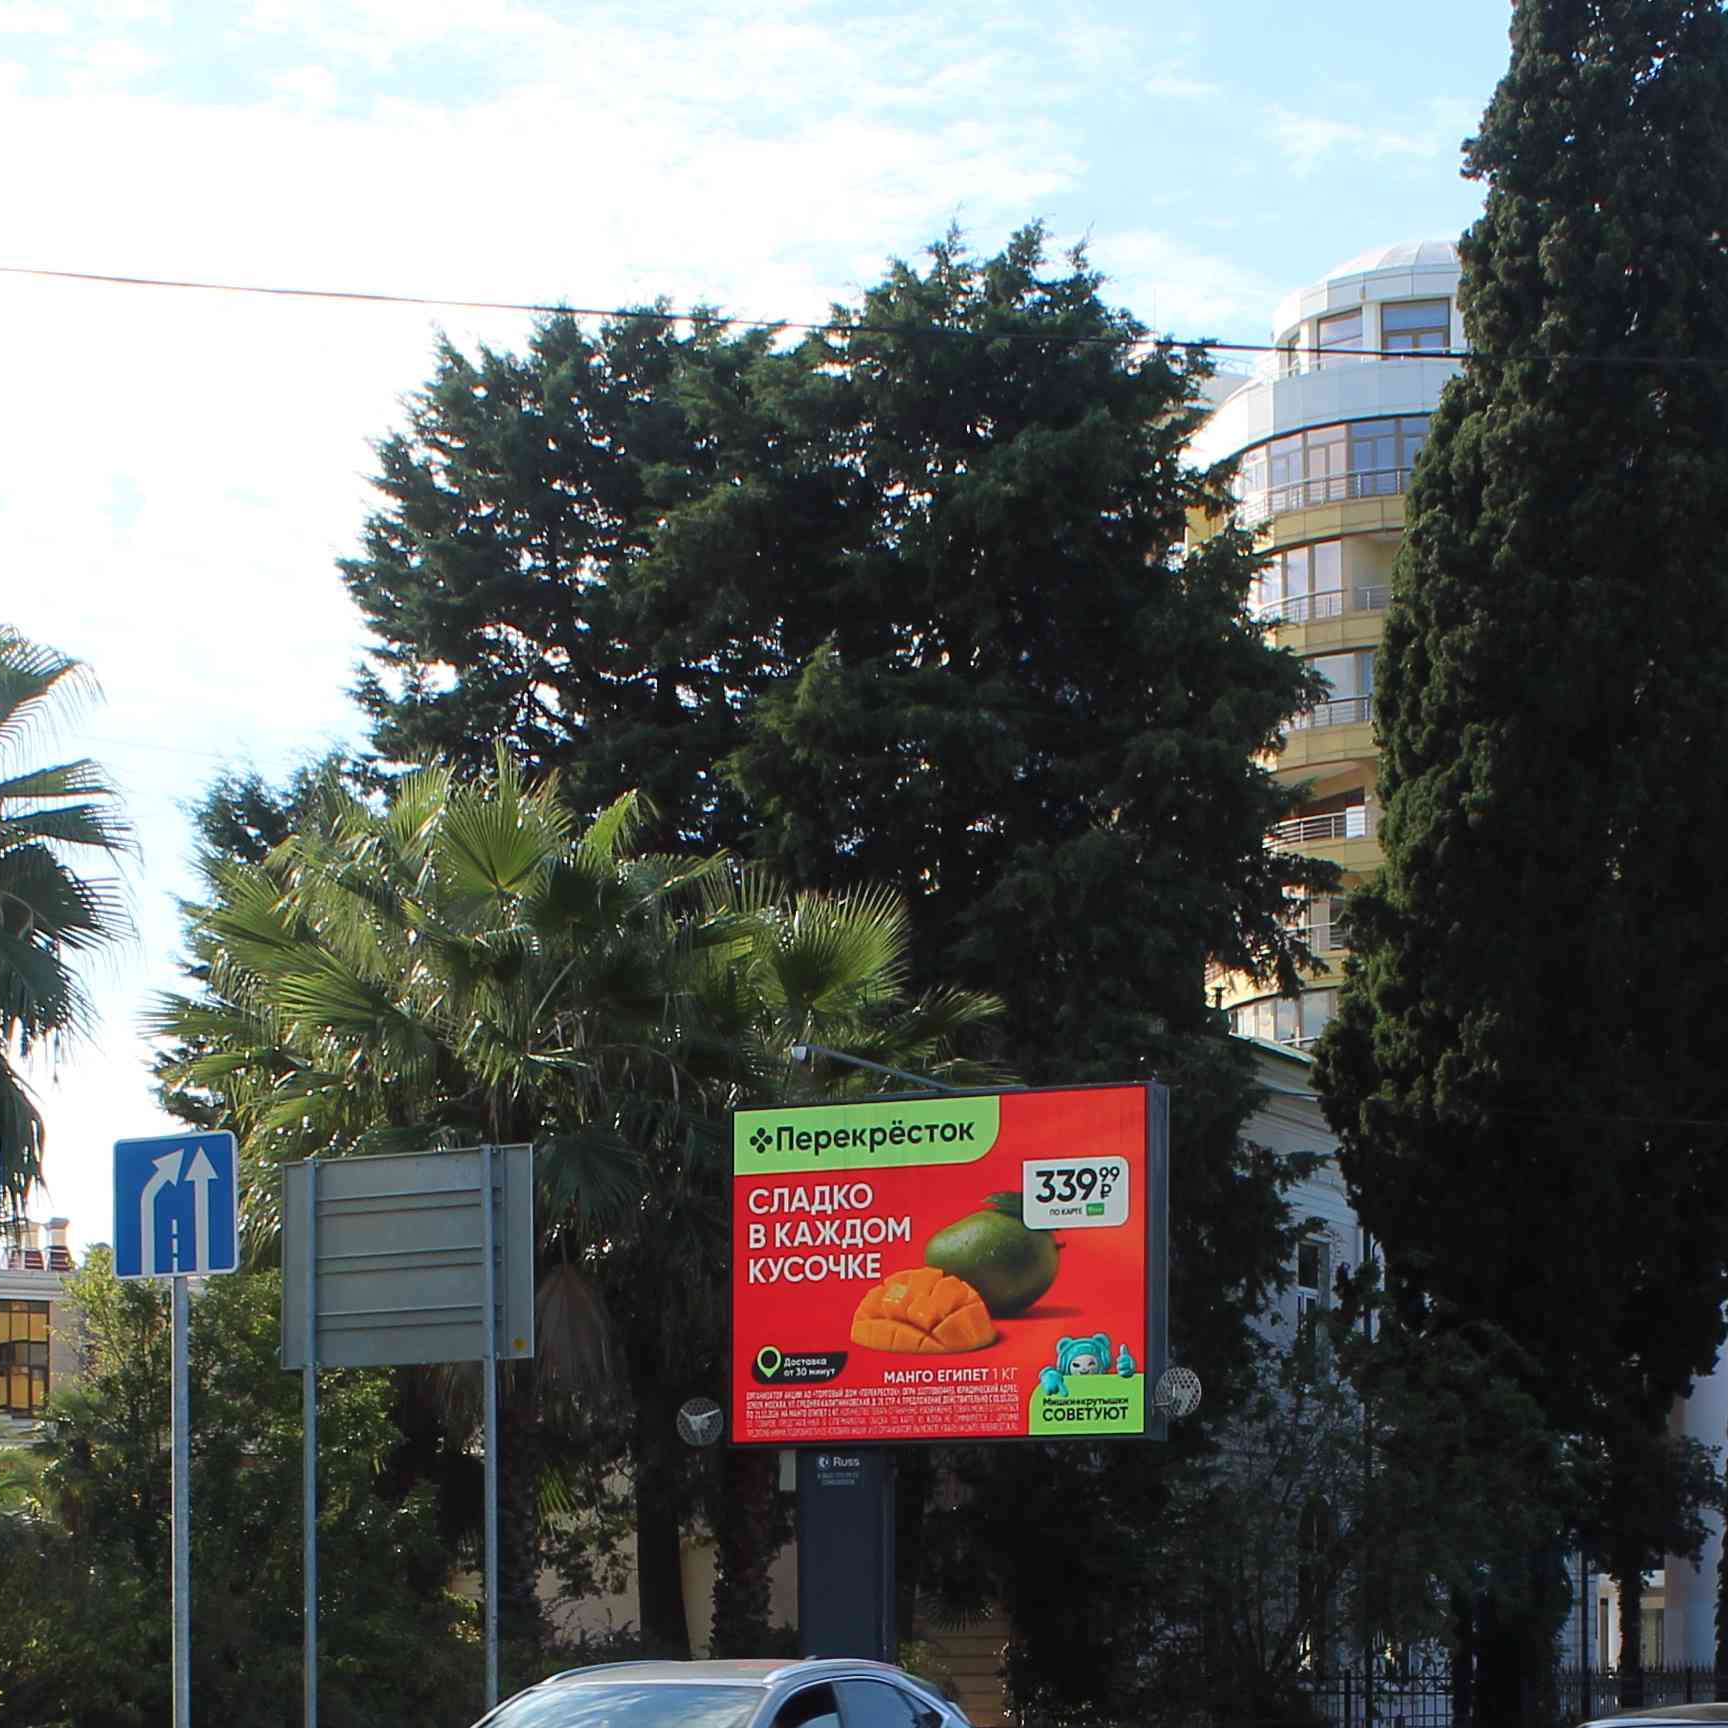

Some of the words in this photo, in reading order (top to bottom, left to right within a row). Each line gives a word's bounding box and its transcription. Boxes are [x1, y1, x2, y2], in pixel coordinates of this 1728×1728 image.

[776, 1119, 975, 1156] Перекрёсток
[748, 1183, 873, 1215] СЛАДКО
[1035, 1167, 1098, 1203] 339
[1099, 1166, 1120, 1182] 99
[748, 1223, 767, 1249] В
[774, 1216, 912, 1248] КАЖДОМ
[748, 1252, 882, 1284] КУСОЧКЕ
[783, 1357, 827, 1368] Доставка
[795, 1367, 807, 1377] 30
[808, 1367, 836, 1377] минут
[884, 1370, 934, 1384] МАНГО
[937, 1368, 989, 1383] ЕГИПЕТ
[1001, 1367, 1019, 1381] КГ
[1042, 1407, 1129, 1422] СОВЕТУЮТ
